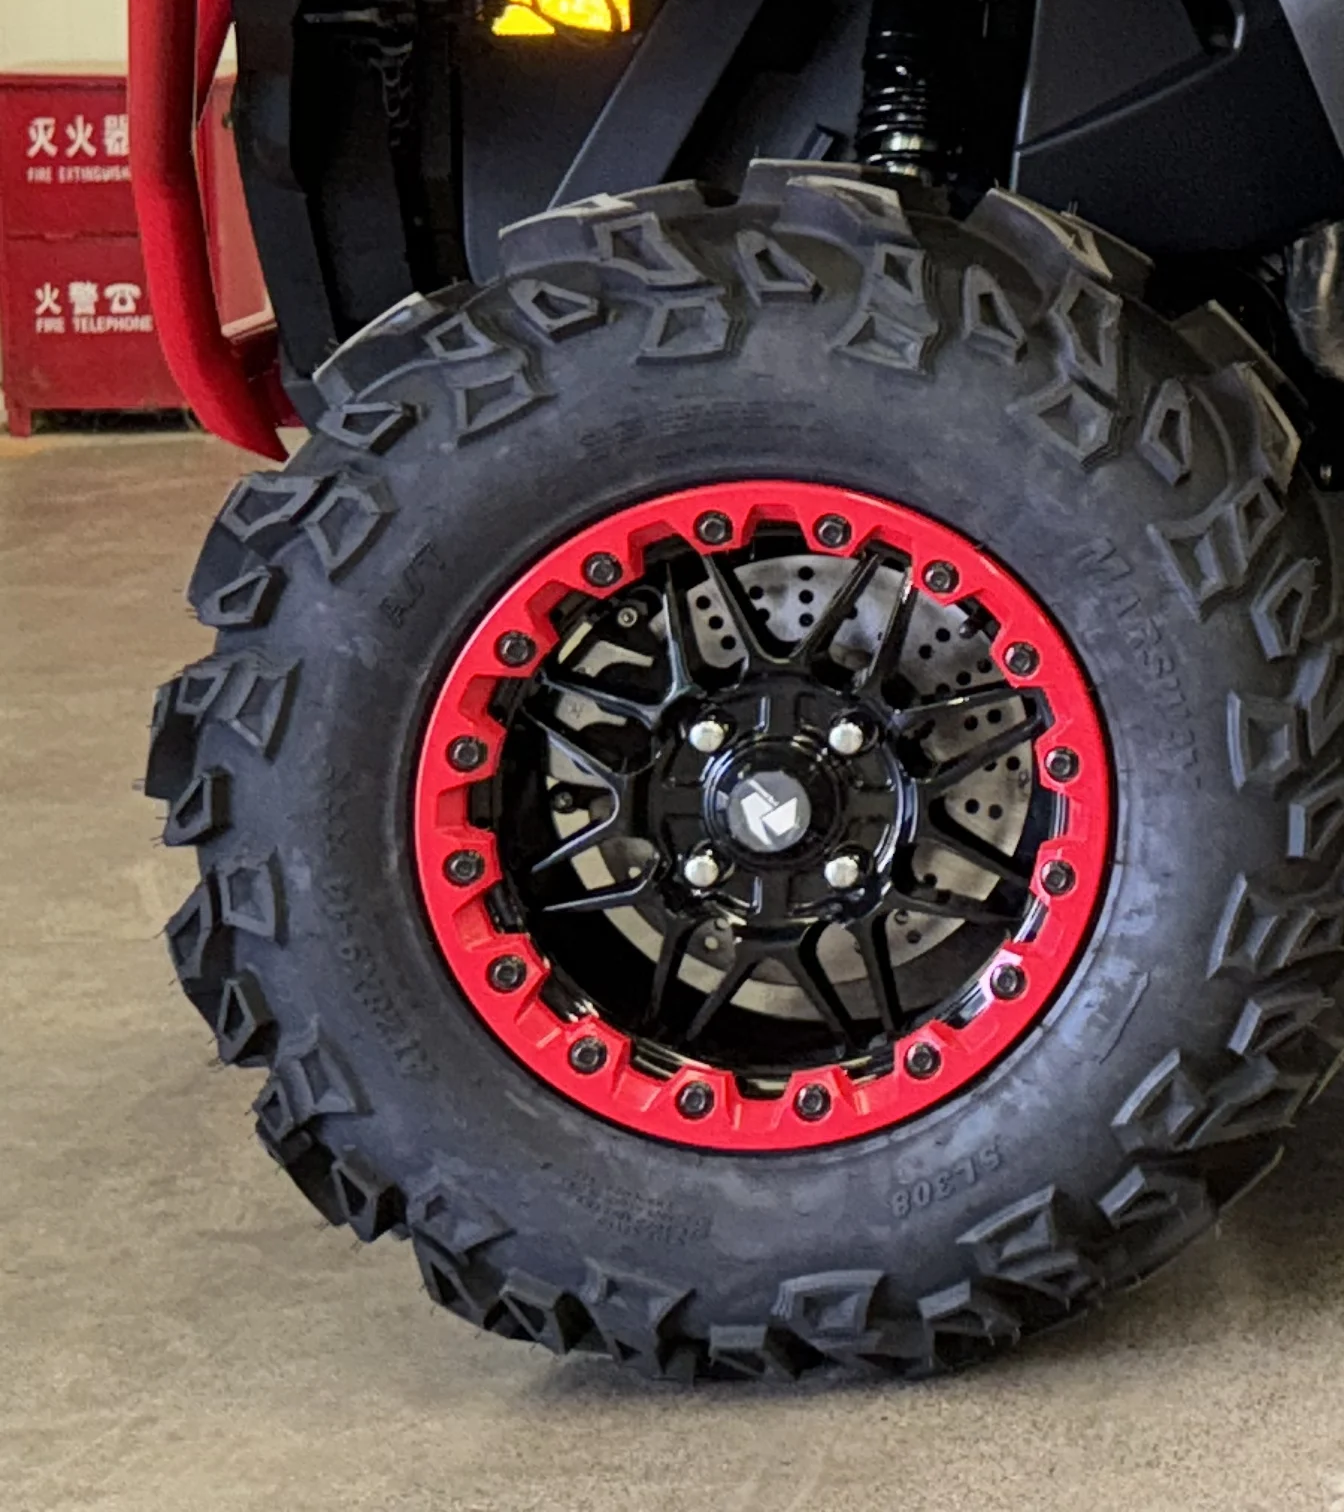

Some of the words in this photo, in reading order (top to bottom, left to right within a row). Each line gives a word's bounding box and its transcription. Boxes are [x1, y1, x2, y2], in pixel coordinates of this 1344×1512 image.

[27, 114, 130, 158] 灭火器
[27, 166, 52, 184] FIRE
[58, 165, 131, 184] EXTINGUISH
[35, 316, 65, 333] FIRE
[73, 315, 153, 333] TELEPHONE
[888, 1144, 1003, 1220] SL308
